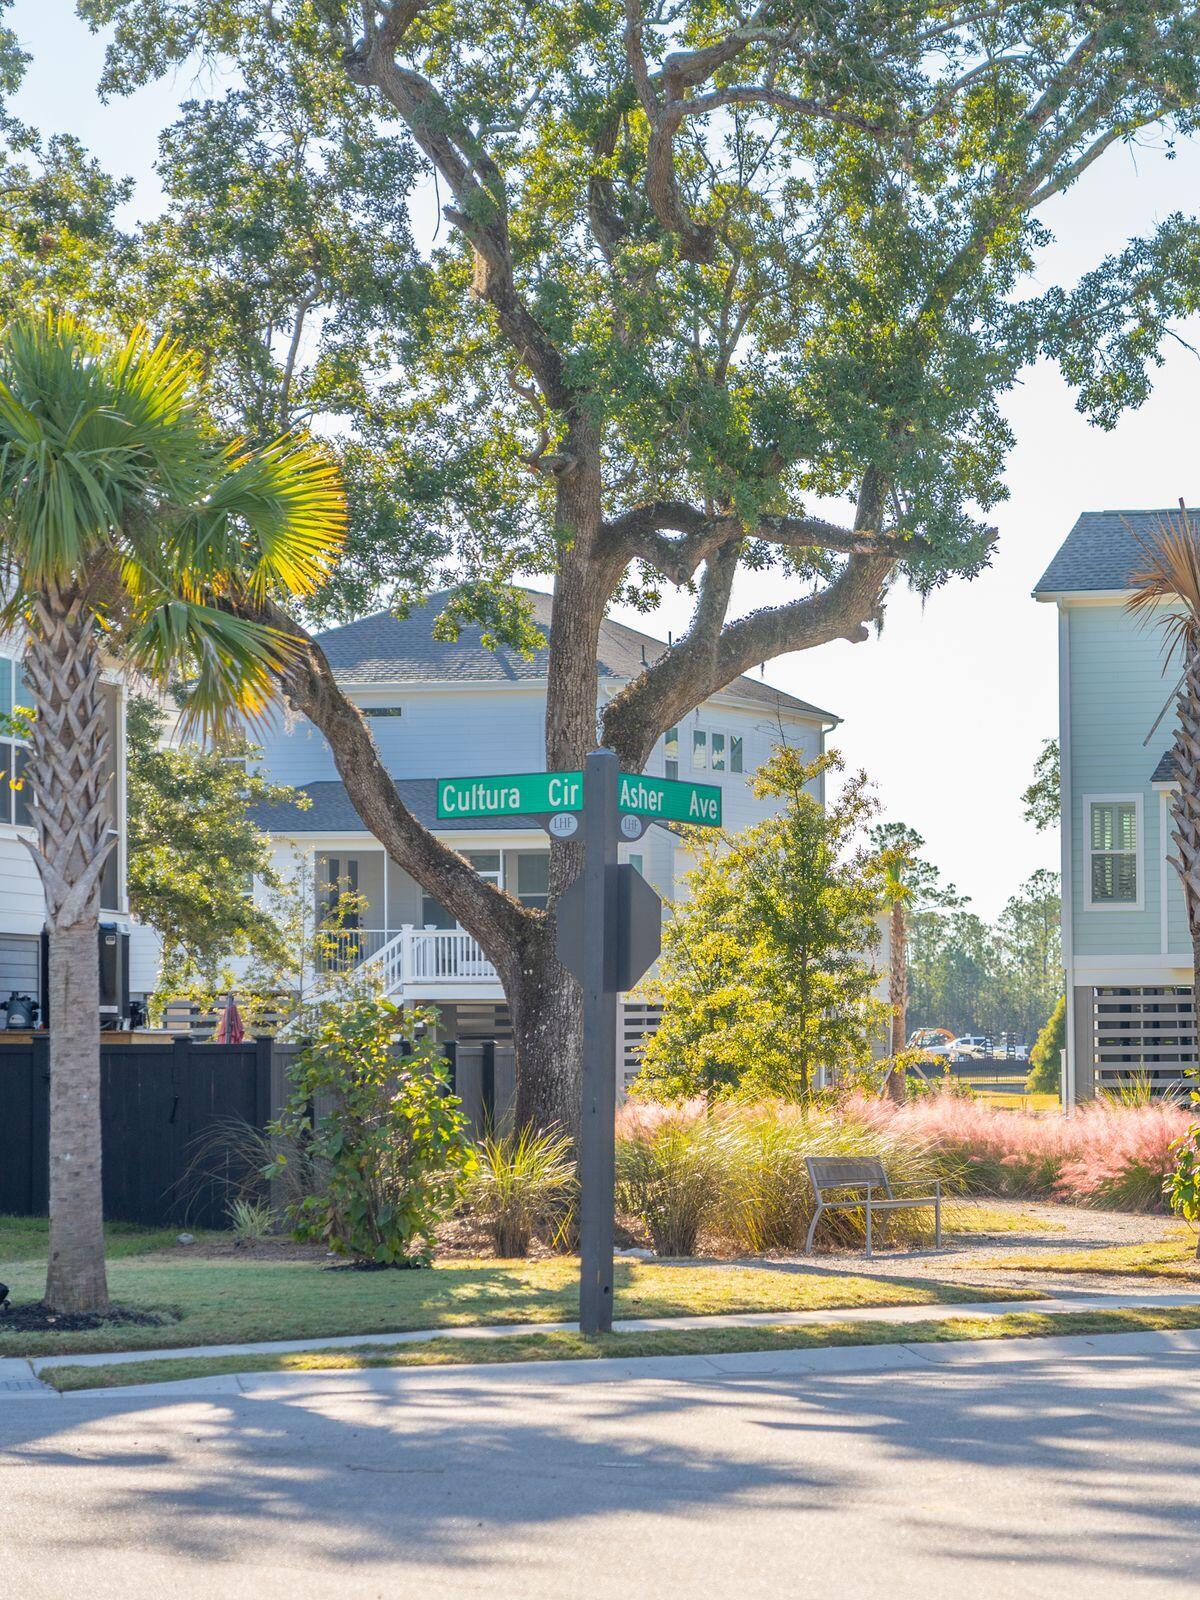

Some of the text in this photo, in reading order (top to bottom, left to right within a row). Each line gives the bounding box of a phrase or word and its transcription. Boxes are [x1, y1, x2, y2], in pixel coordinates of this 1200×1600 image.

[443, 778, 579, 812] Cultura Cir
[620, 780, 718, 820] Asher Ave
[553, 816, 573, 829] LHF
